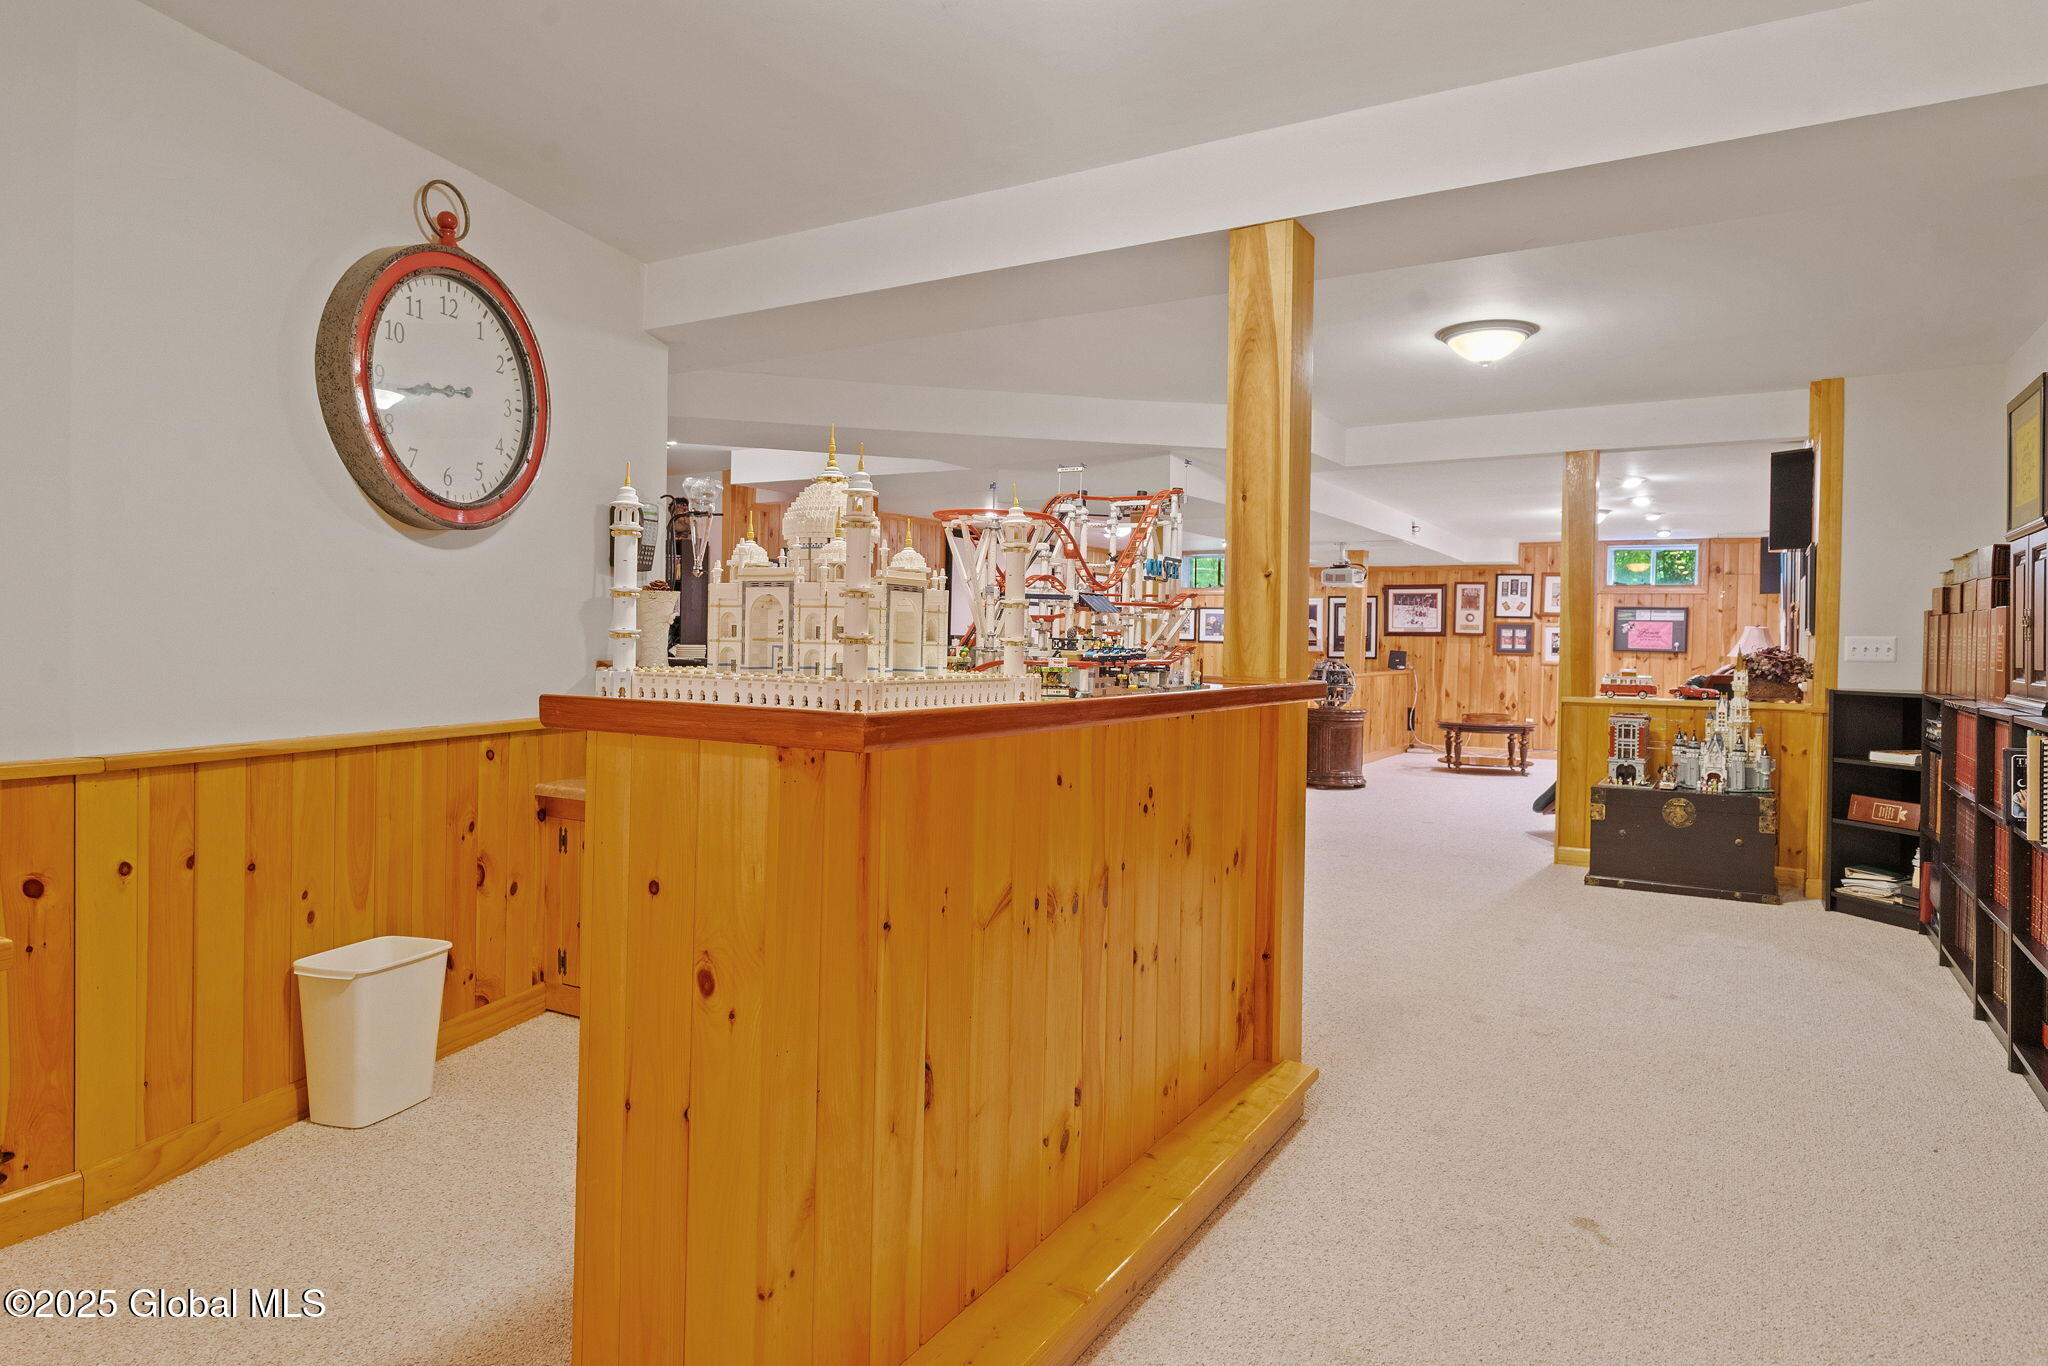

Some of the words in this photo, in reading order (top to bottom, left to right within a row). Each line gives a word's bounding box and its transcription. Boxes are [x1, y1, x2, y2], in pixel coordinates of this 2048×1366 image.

[406, 296, 424, 320] 11
[440, 295, 459, 319] 12
[385, 319, 405, 343] 10
[477, 321, 485, 341] 1
[374, 364, 385, 385] 9
[496, 355, 505, 375] 2
[503, 399, 512, 418] 3
[385, 414, 395, 435] 8
[495, 438, 504, 455] 4
[408, 447, 419, 468] 7
[443, 466, 453, 487] 6
[474, 462, 484, 481] 5
